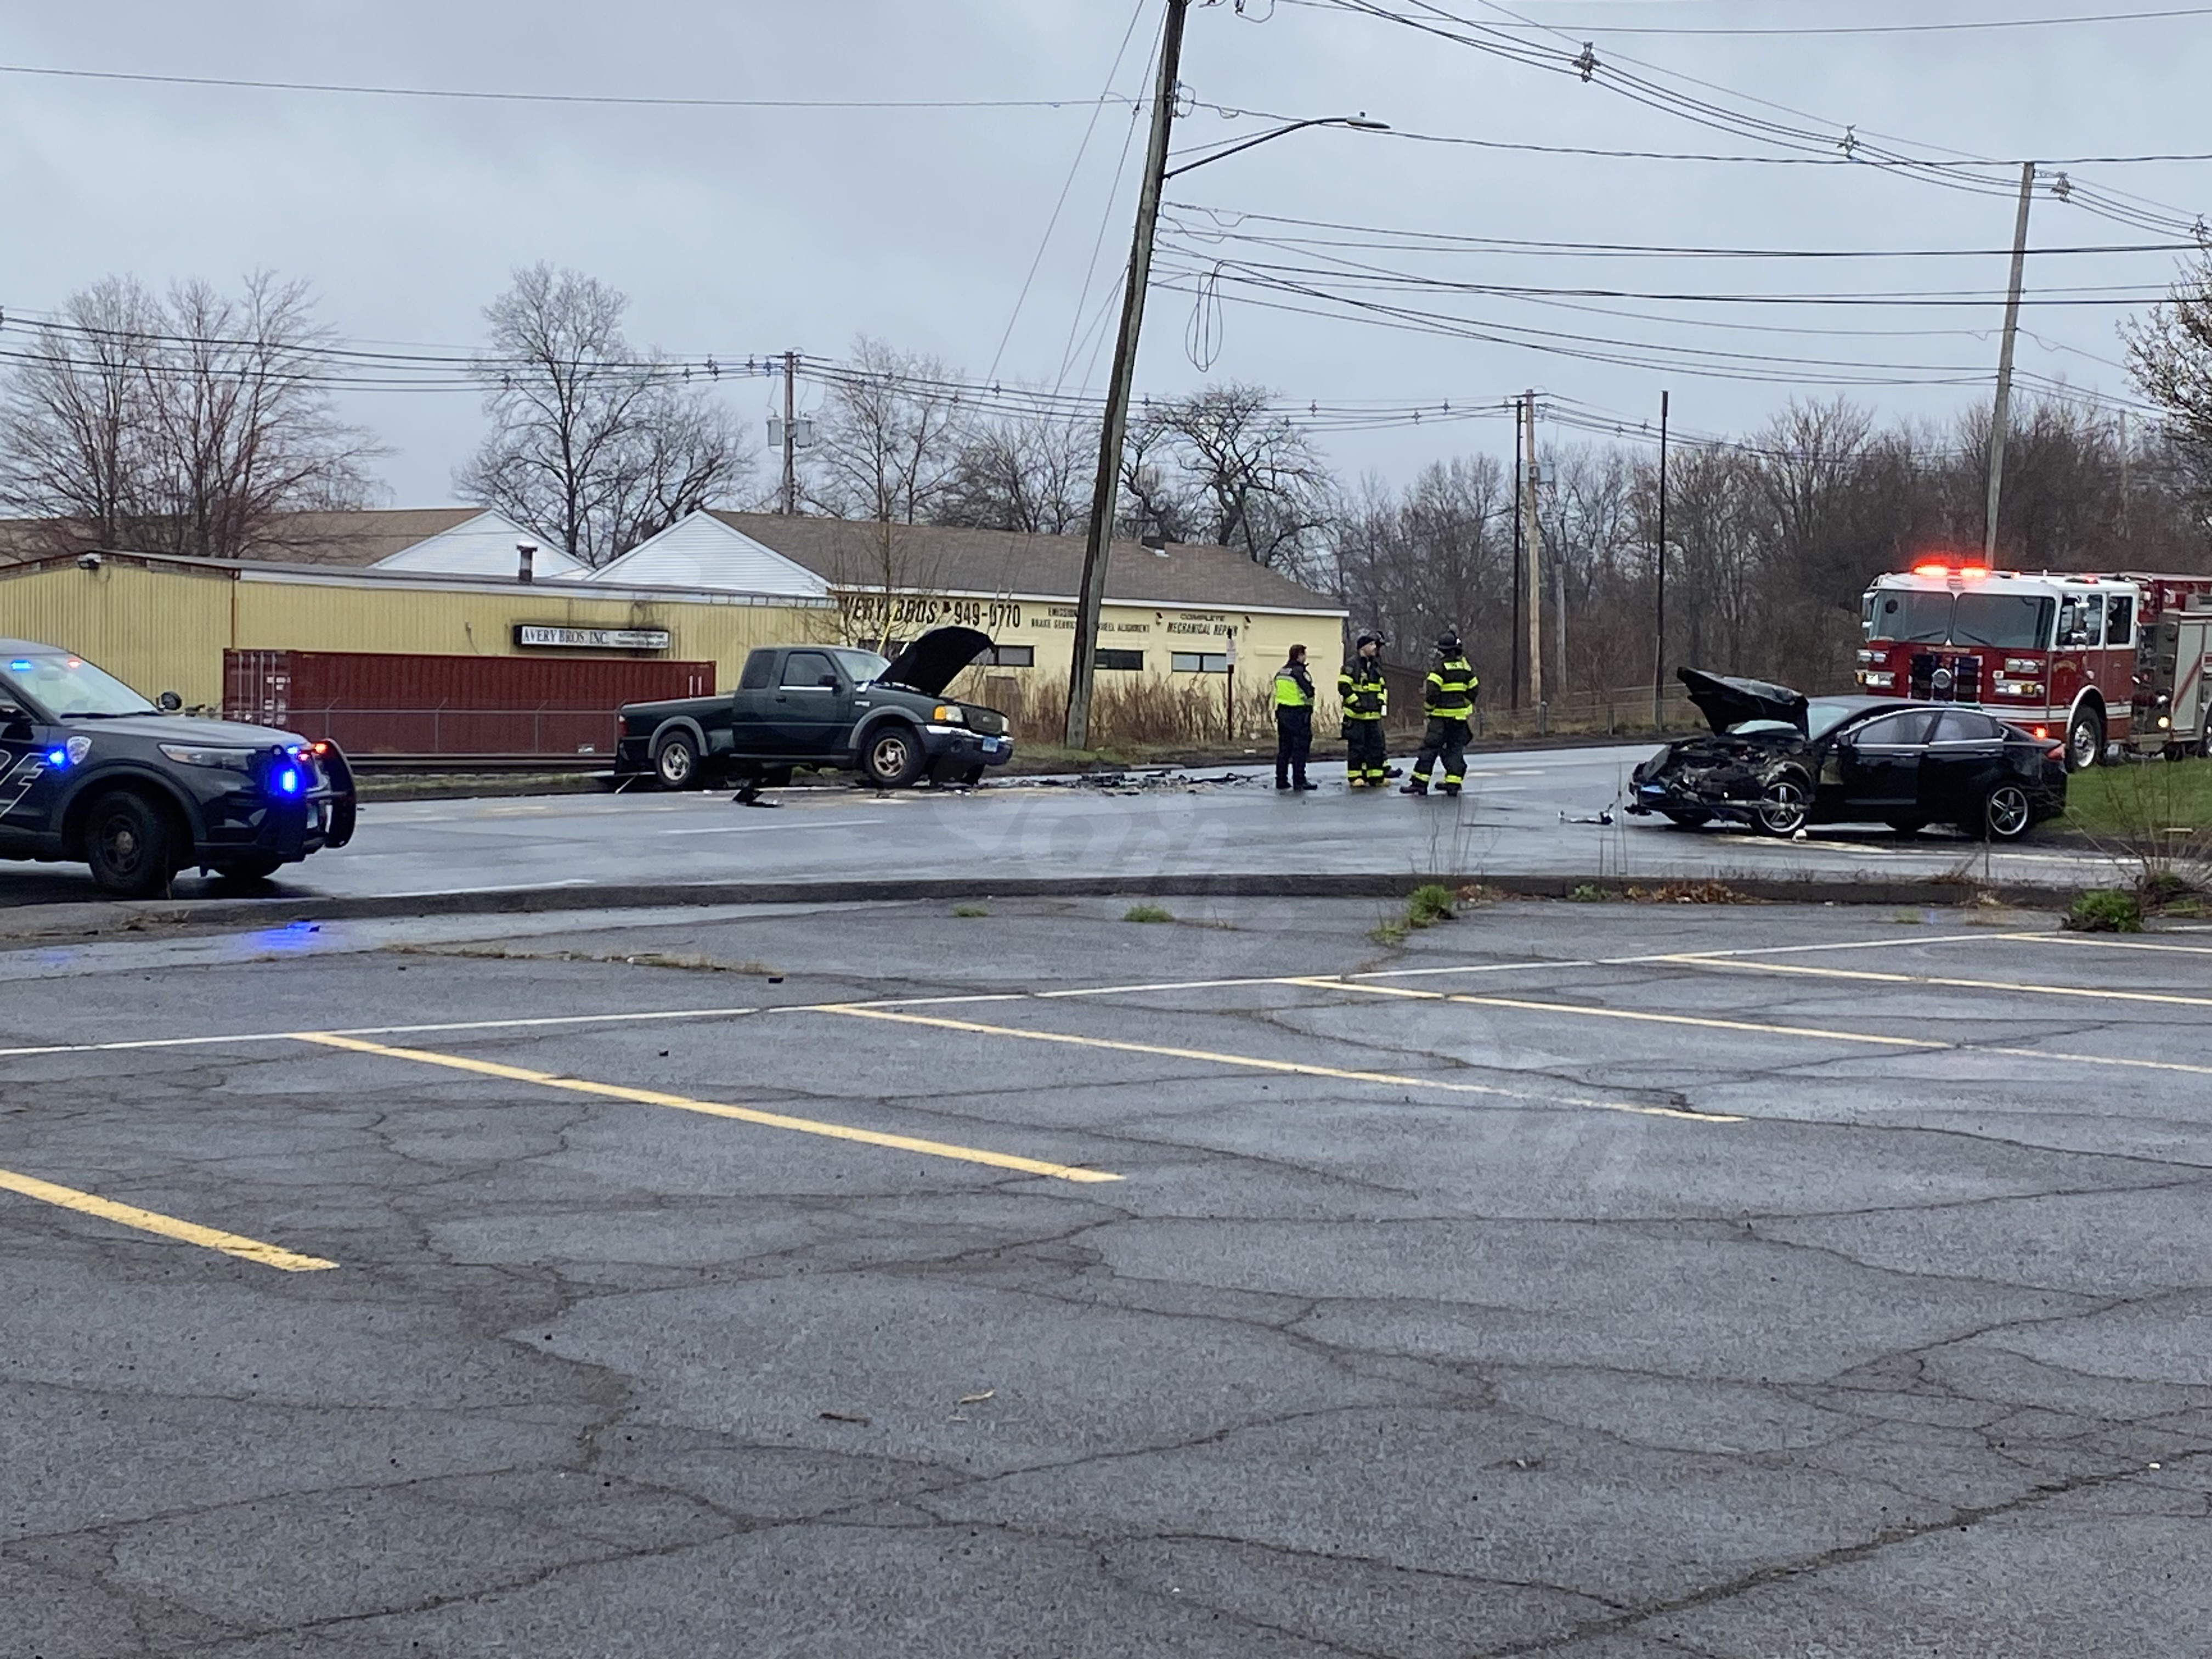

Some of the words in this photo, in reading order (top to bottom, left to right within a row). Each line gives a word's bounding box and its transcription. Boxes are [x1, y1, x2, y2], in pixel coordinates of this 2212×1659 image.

[1180, 613, 1226, 622] COMPLETE
[523, 628, 557, 642] AVERY
[1167, 622, 1210, 635] MECHANICAL
[1214, 624, 1238, 636] REPIR
